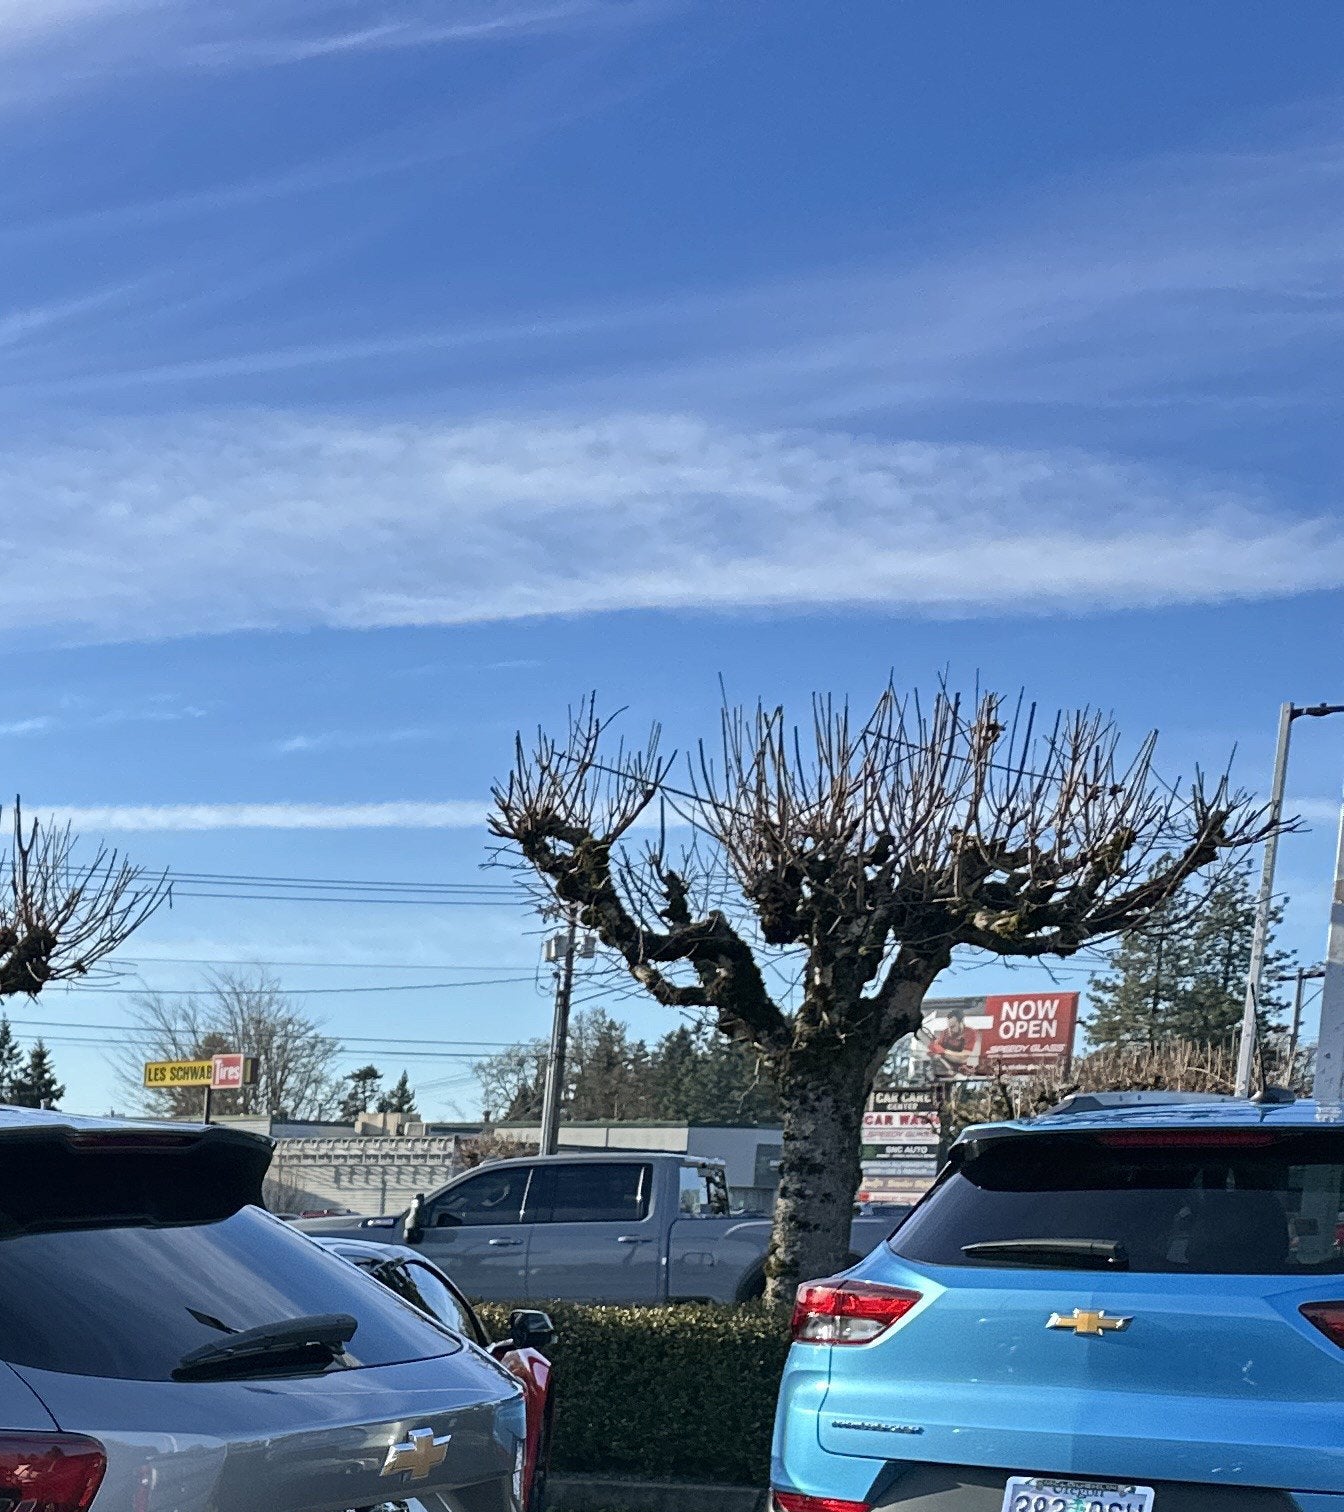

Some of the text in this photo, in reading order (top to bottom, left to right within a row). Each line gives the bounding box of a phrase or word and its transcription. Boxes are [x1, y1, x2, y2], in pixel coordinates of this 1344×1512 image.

[1000, 999, 1060, 1021] NOW
[998, 1020, 1058, 1039] OPEN
[148, 1059, 241, 1085] LES SCHWAB Tires
[864, 1114, 893, 1126] CAR
